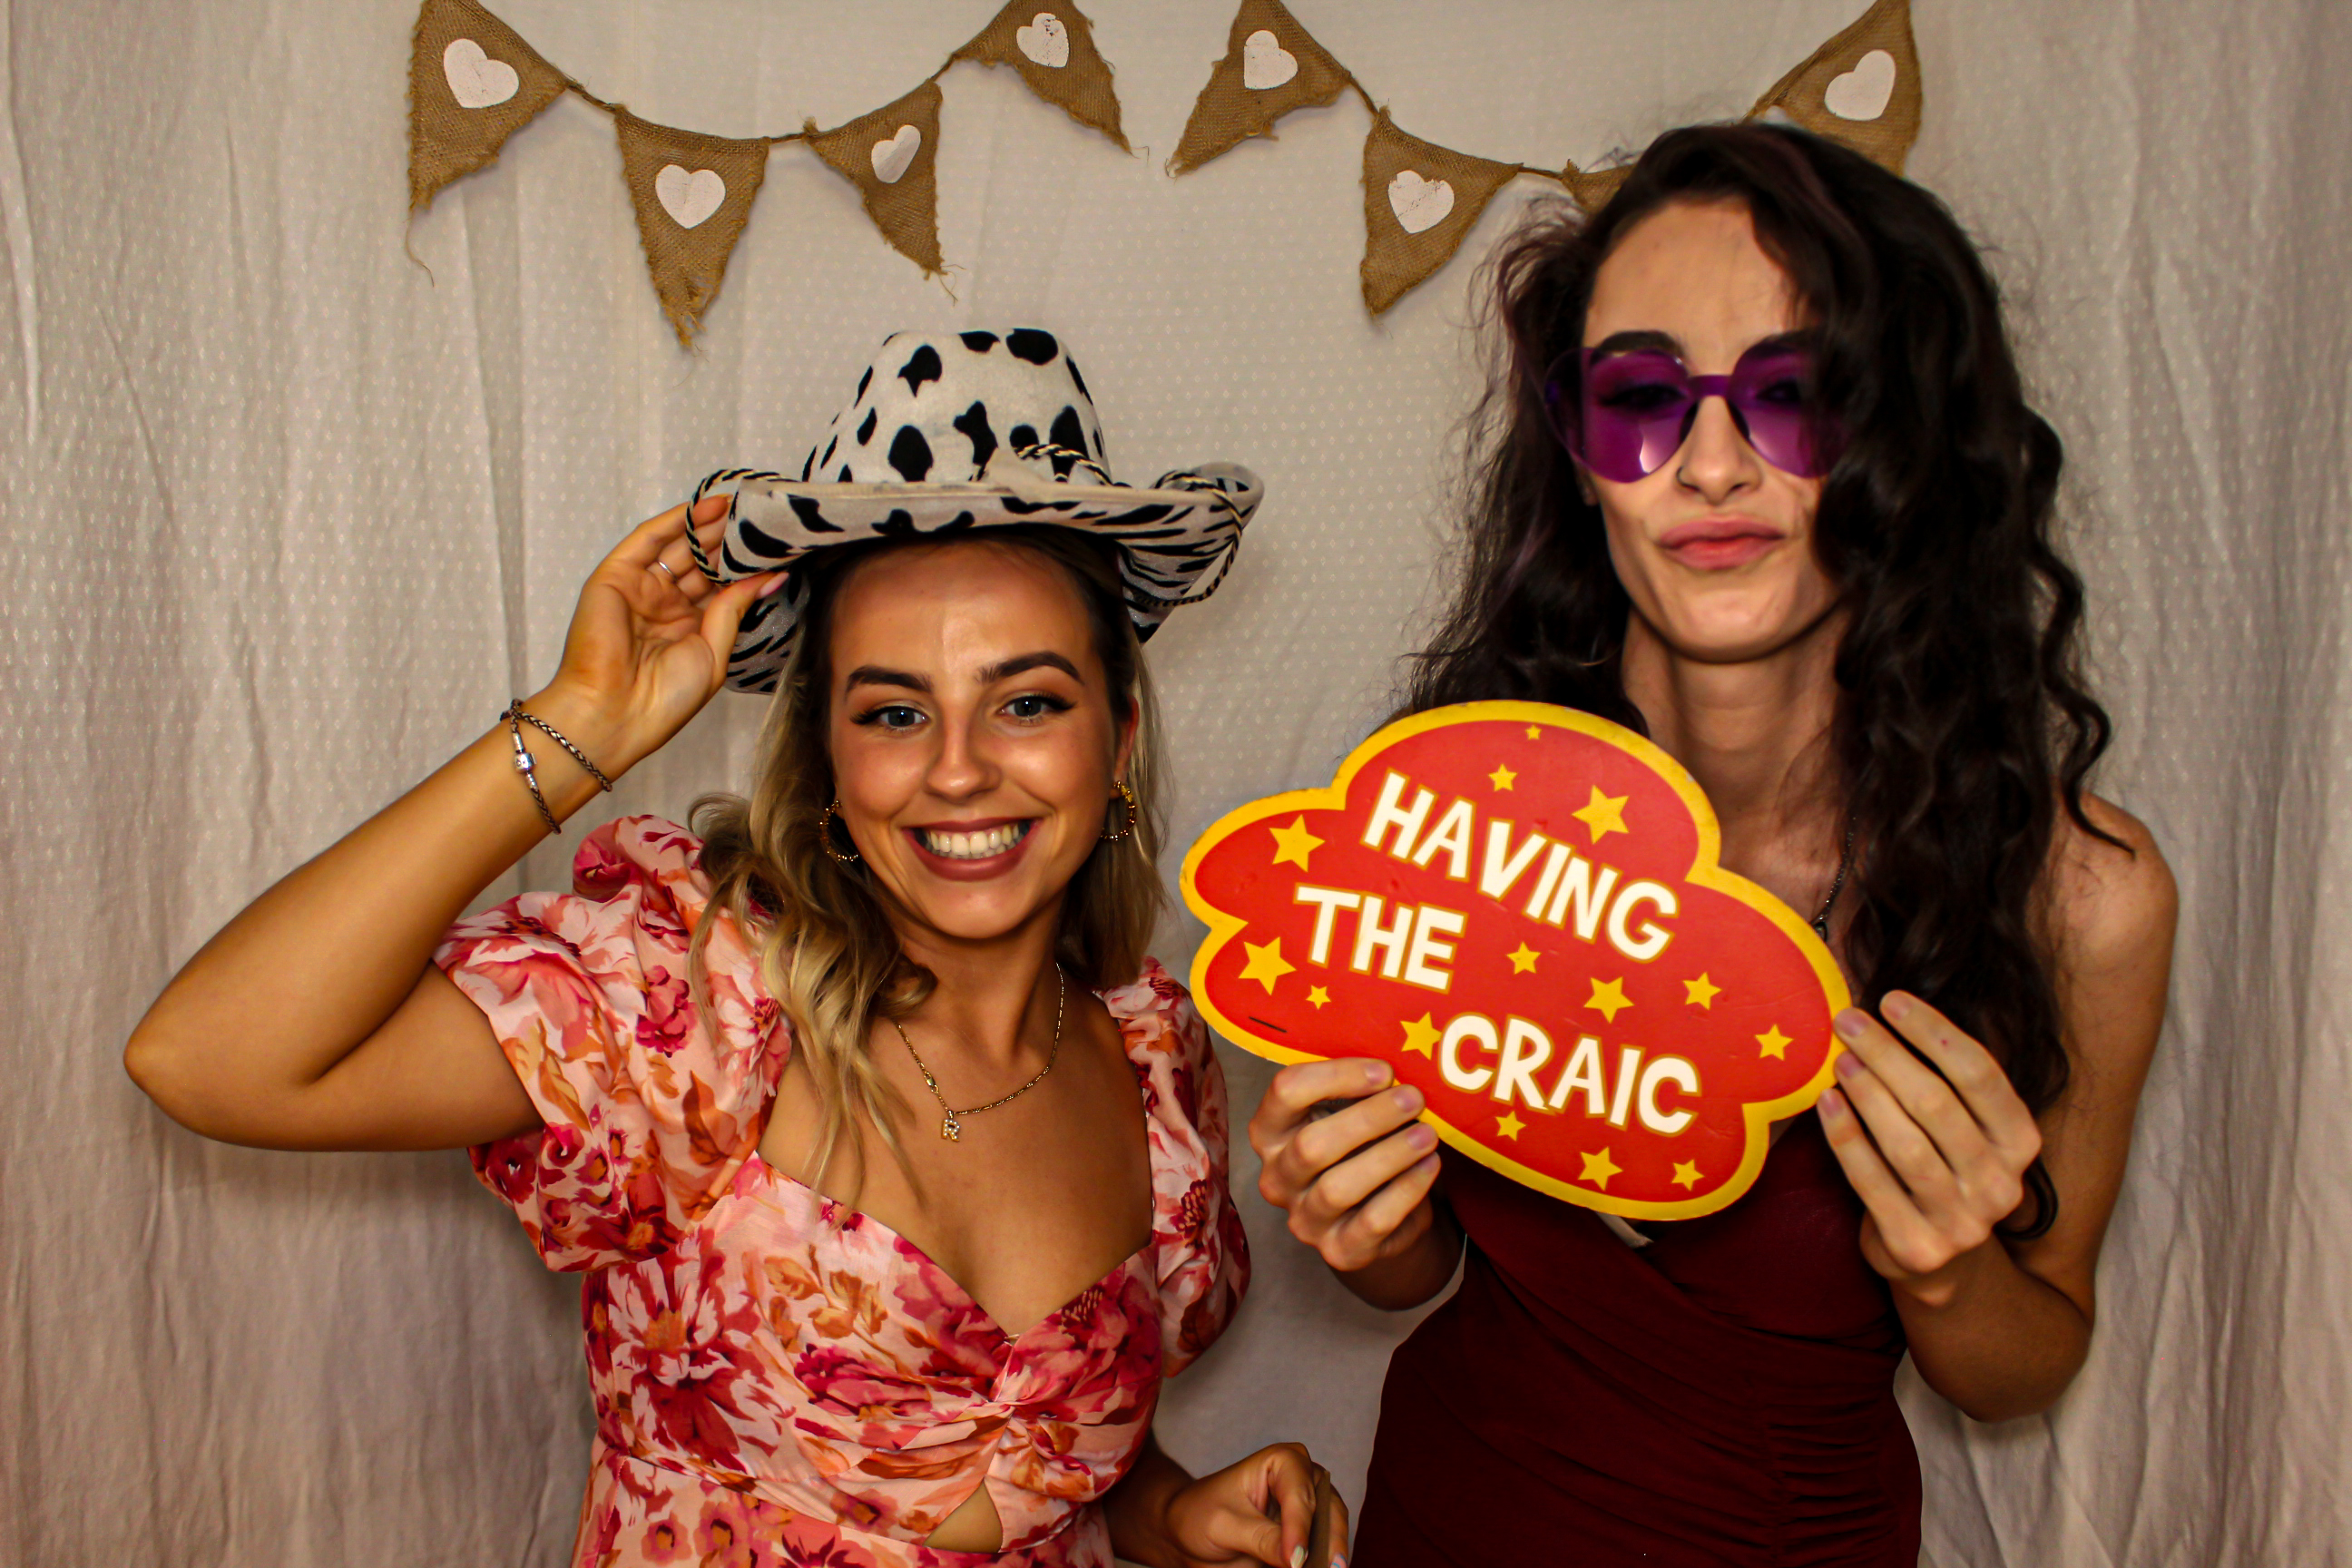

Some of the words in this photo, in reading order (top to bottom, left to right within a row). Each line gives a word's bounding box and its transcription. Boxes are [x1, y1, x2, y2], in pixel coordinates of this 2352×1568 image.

[1363, 769, 1680, 962] HAVING
[1295, 886, 1465, 991] THE
[941, 1118, 960, 1142] R
[1440, 1014, 1700, 1134] CRAIC
